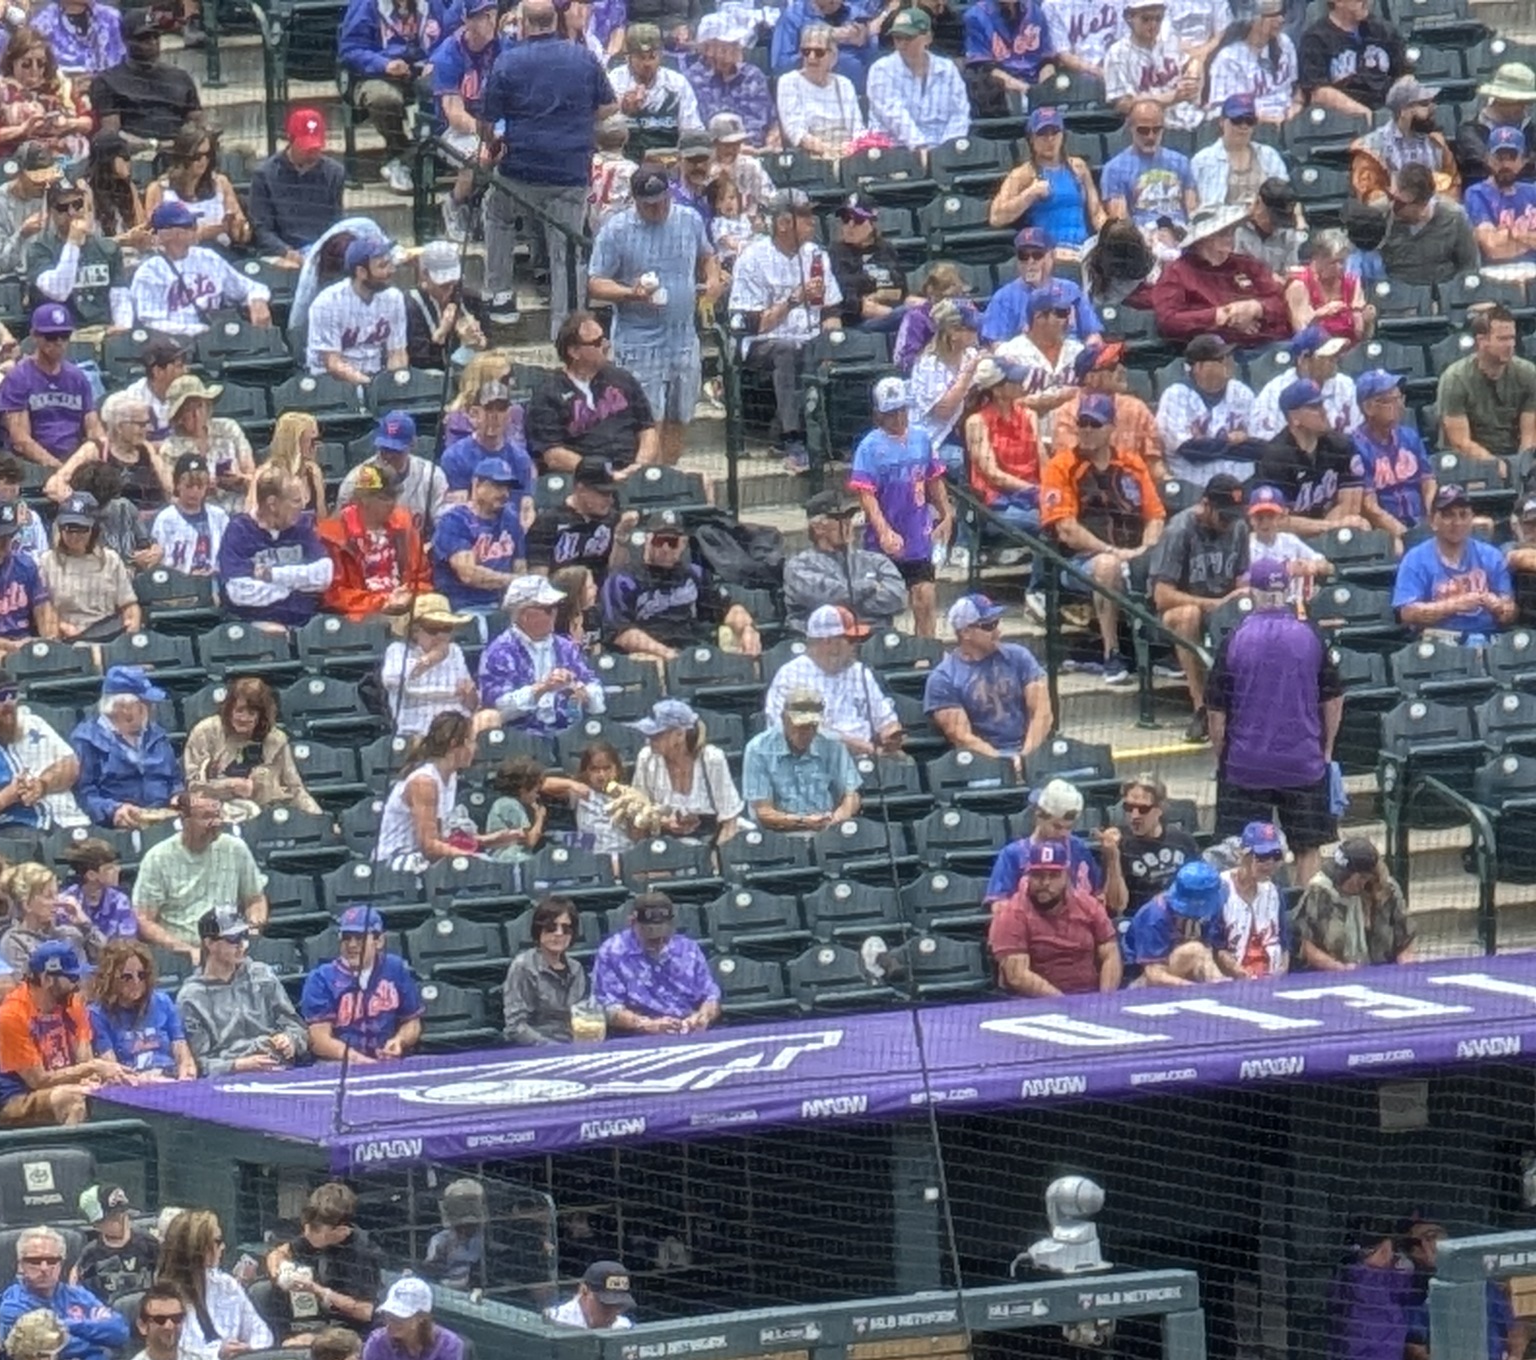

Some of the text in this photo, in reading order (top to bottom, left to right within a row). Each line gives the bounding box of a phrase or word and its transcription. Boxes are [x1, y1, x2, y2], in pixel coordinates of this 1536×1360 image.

[1457, 1036, 1522, 1060] ARROW
[1239, 1056, 1305, 1079] ARROW
[1021, 1075, 1086, 1098] ARROW
[801, 1094, 868, 1118] ARROW
[580, 1116, 647, 1141] ARROW
